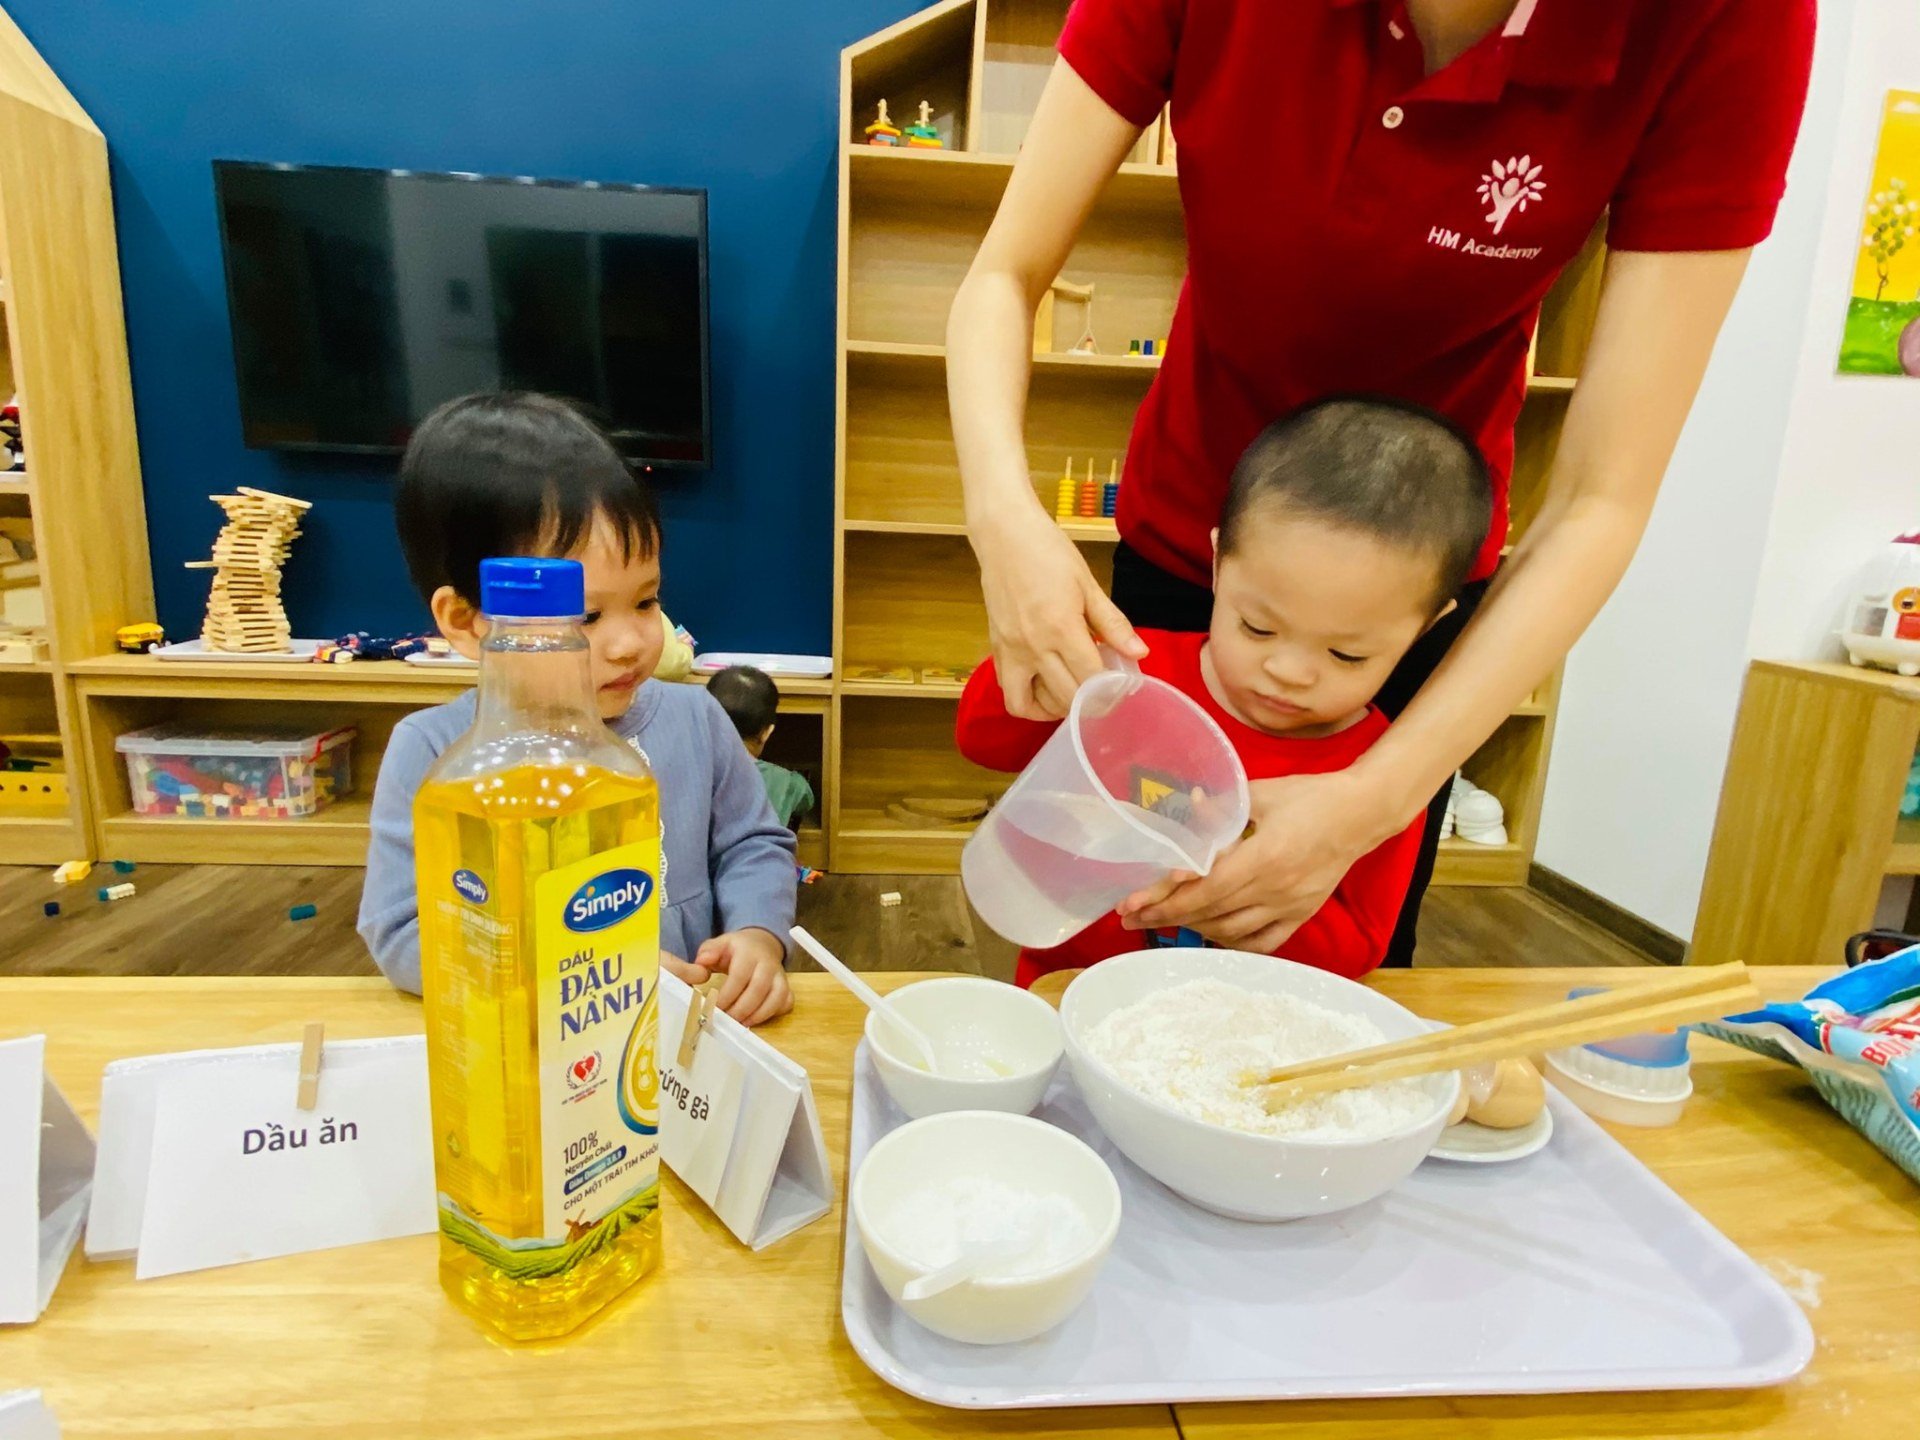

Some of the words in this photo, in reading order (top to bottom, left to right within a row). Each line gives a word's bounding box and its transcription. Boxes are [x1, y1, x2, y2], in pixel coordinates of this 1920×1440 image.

[1427, 226, 1461, 249] HM
[1461, 238, 1542, 259] Academy
[456, 873, 487, 901] Simply
[573, 881, 647, 922] Simply
[561, 977, 643, 1041] NÀNH
[690, 1094, 710, 1122] gà
[243, 1122, 307, 1155] Dầu
[319, 1117, 358, 1145] ăn
[563, 1129, 599, 1164] 100%
[563, 1193, 583, 1211] CHO
[624, 1156, 639, 1171] TIM
